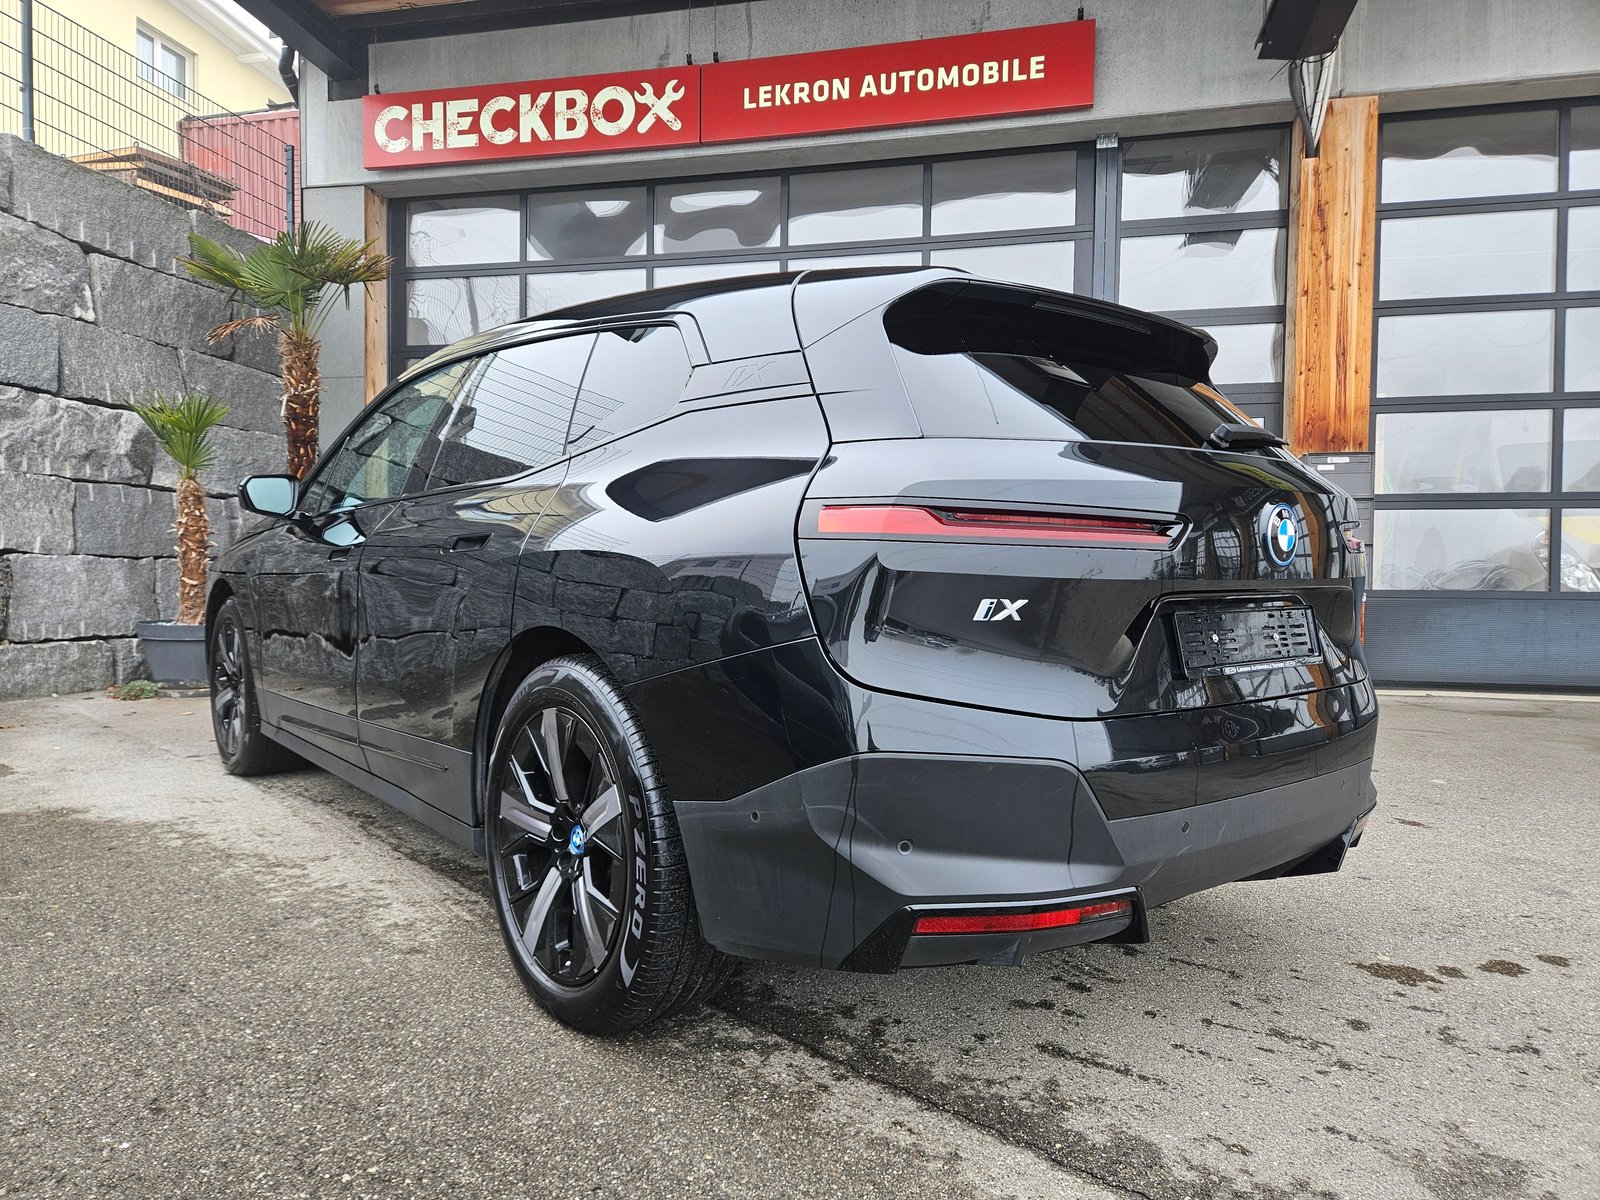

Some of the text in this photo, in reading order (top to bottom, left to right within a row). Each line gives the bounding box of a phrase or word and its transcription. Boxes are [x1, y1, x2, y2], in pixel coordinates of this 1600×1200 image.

[743, 55, 1046, 110] LEKRON AUTOMOBILE
[374, 79, 685, 153] CHECKBOX
[972, 598, 1029, 621] iX
[628, 794, 646, 940] P ZERO
